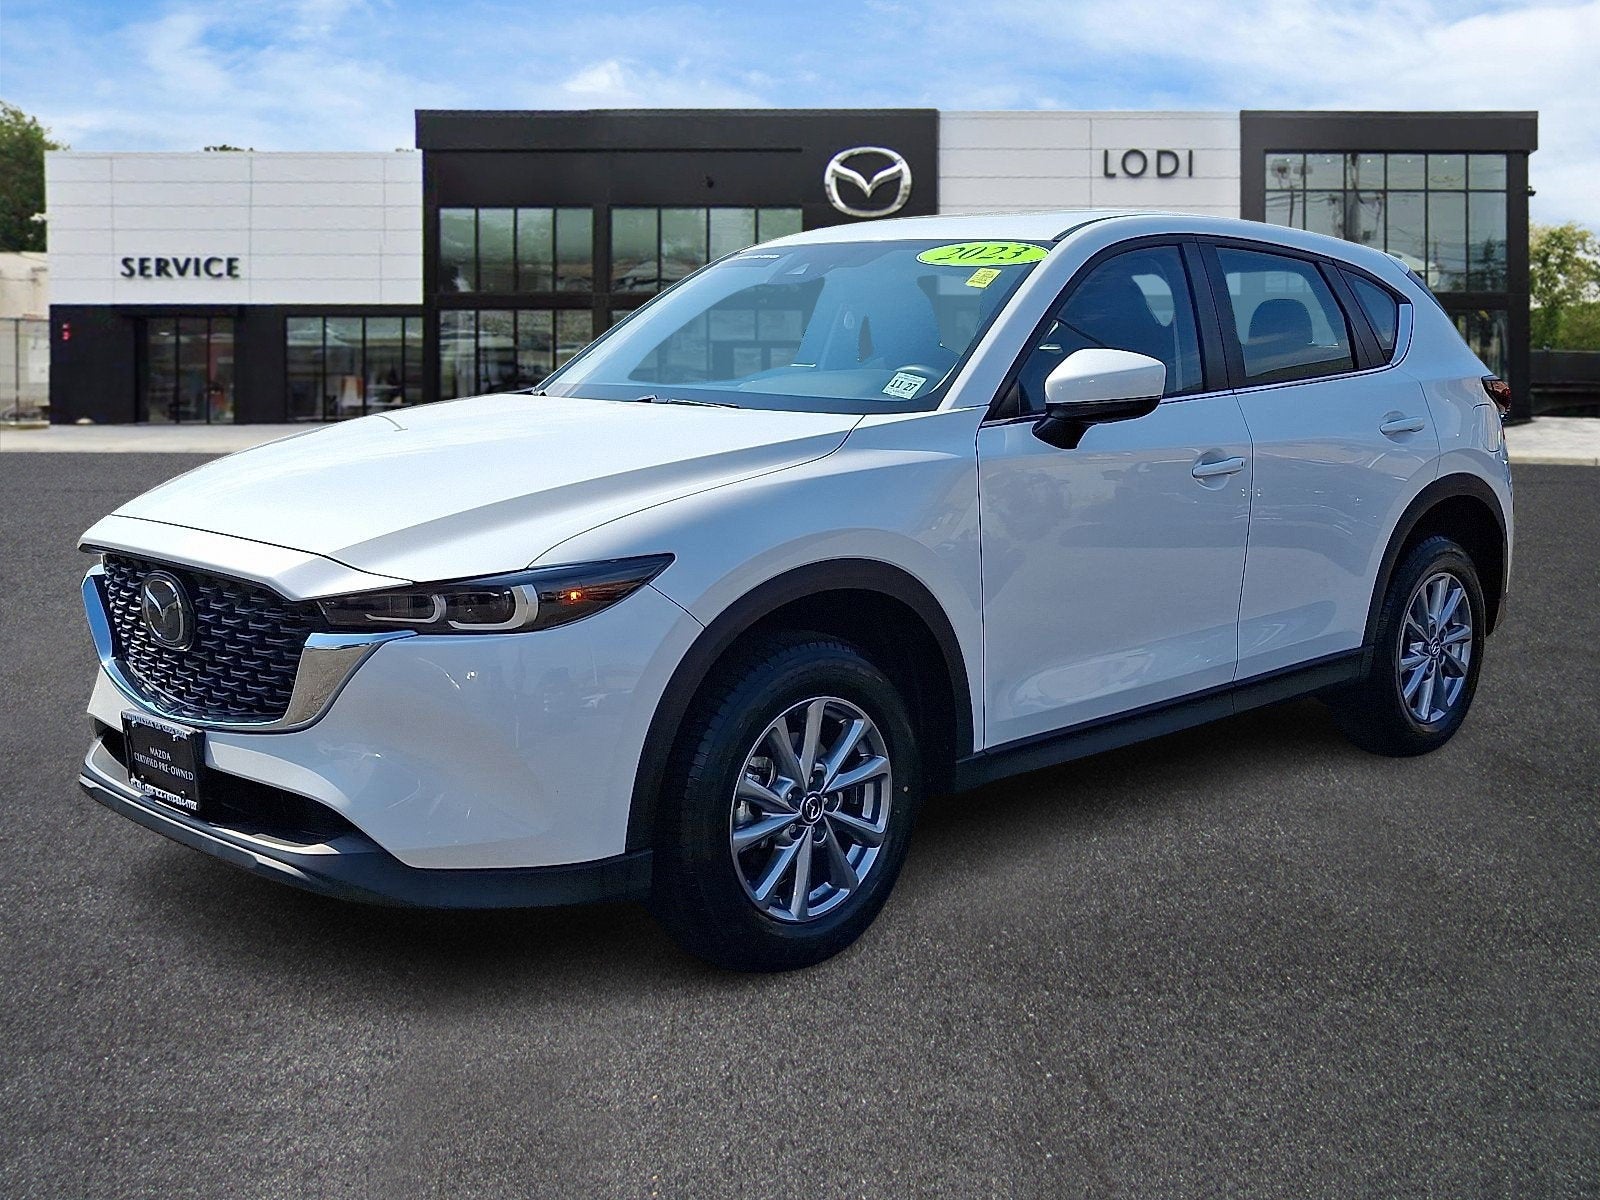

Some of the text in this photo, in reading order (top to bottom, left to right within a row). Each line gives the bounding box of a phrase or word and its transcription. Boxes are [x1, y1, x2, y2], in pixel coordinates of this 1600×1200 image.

[1103, 149, 1193, 178] LODI
[934, 246, 1031, 260] 2023
[120, 257, 240, 278] SERVICE
[149, 746, 171, 761] MAZDA
